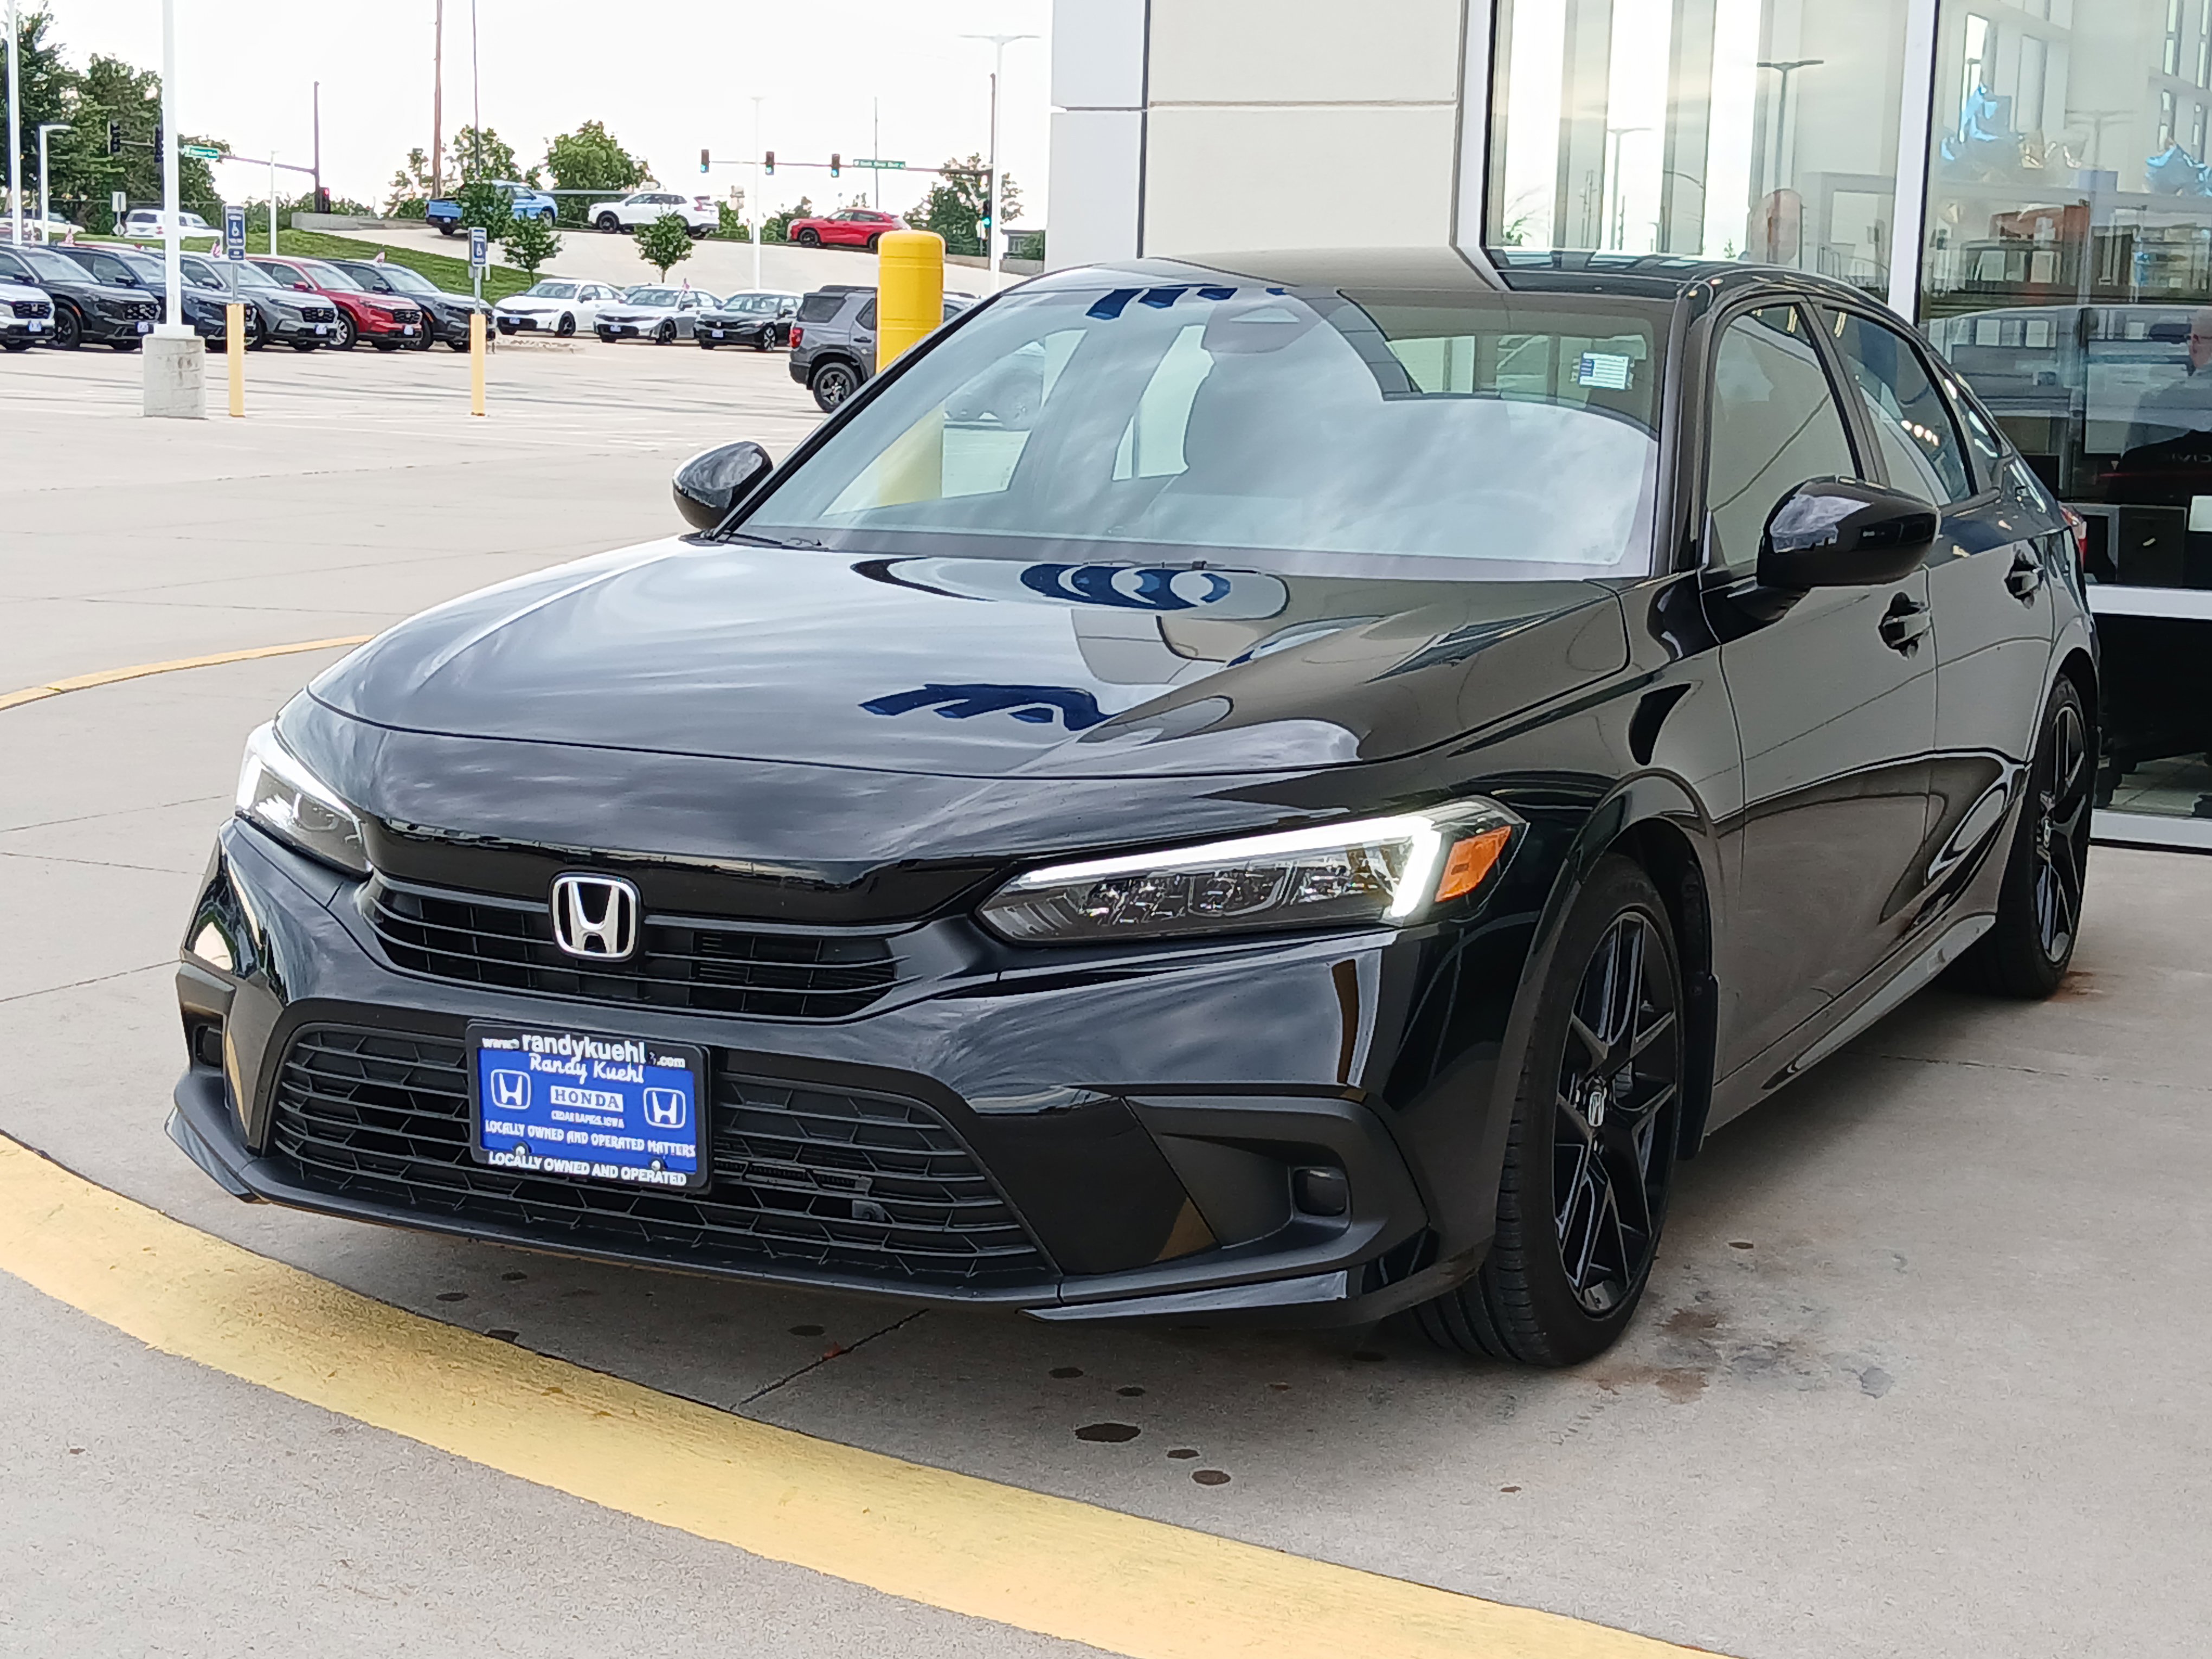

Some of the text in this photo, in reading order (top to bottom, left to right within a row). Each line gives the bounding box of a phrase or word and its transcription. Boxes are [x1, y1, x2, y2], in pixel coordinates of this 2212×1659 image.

[522, 1034, 646, 1064] randykuehl
[528, 1052, 644, 1084] Randy Kuehl
[555, 1089, 619, 1109] HONDA
[485, 1120, 696, 1158] LOCALLY OWNED AND OPERATED MATTERS
[488, 1151, 687, 1186] LOCALLY OWNED AND OPERATED
